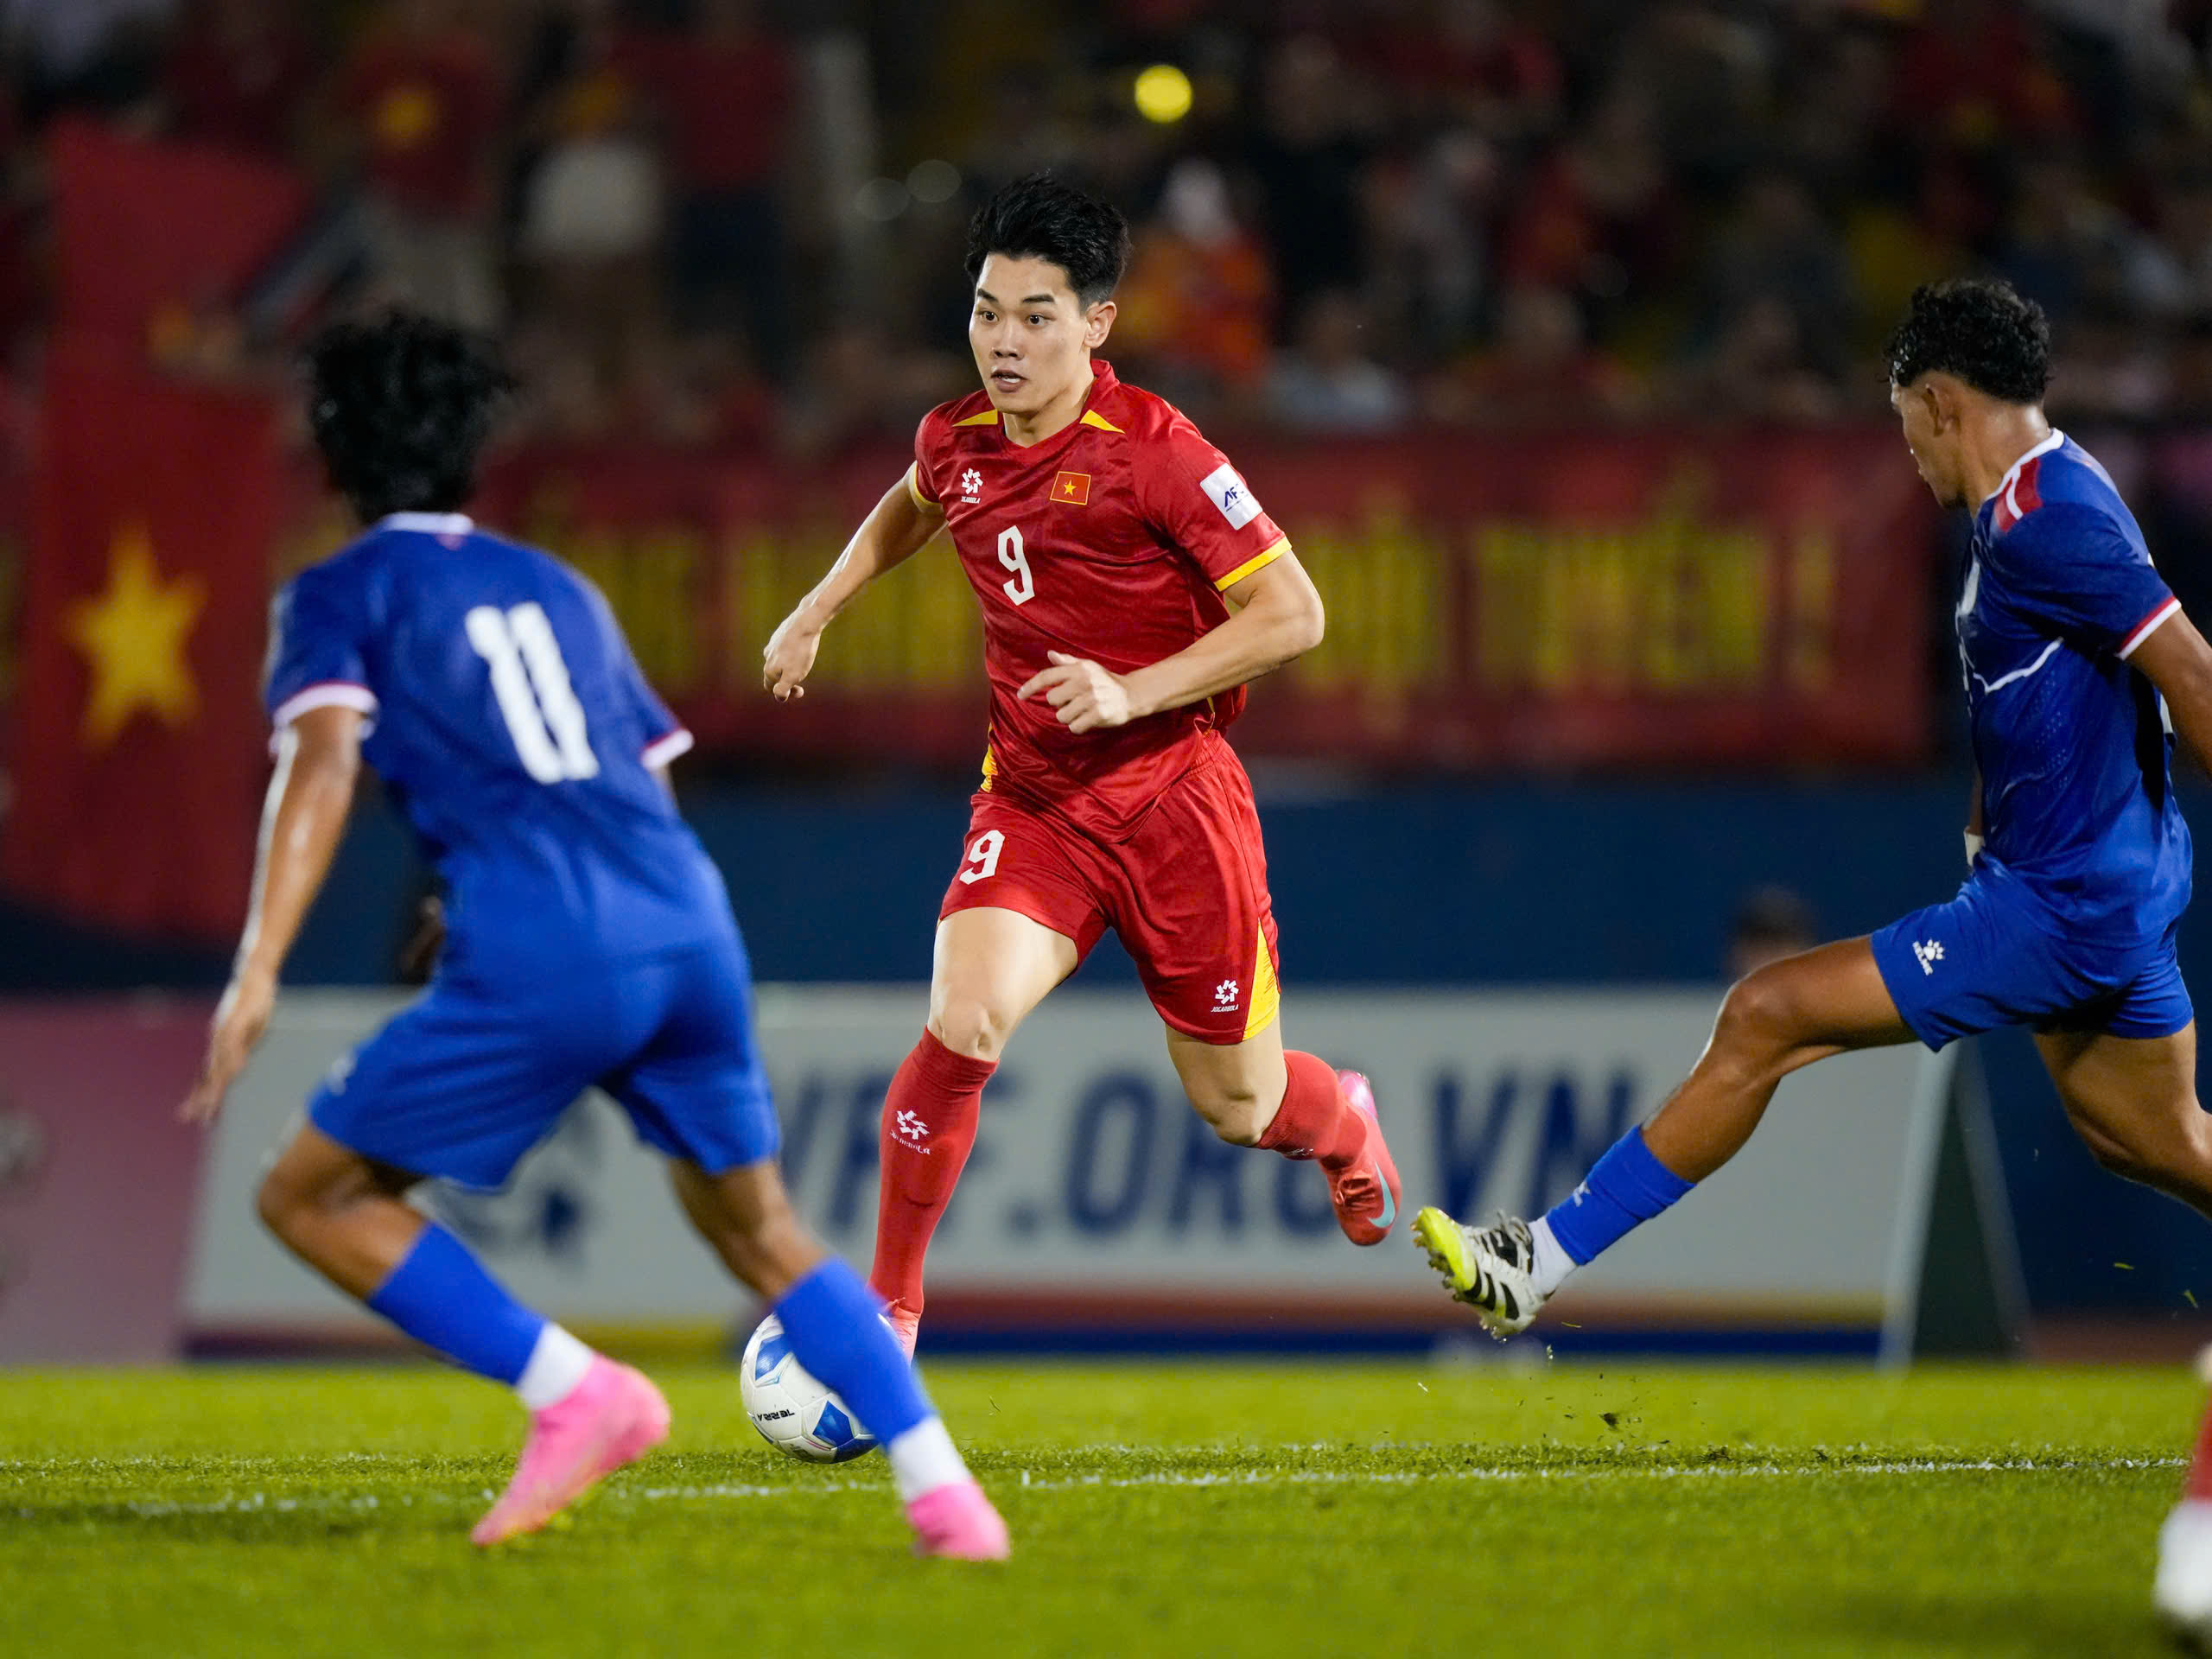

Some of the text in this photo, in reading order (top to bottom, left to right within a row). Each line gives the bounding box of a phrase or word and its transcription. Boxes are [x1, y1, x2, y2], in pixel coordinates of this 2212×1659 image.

[997, 525, 1035, 606] 9
[465, 603, 600, 785] 11
[959, 830, 1006, 885] 9
